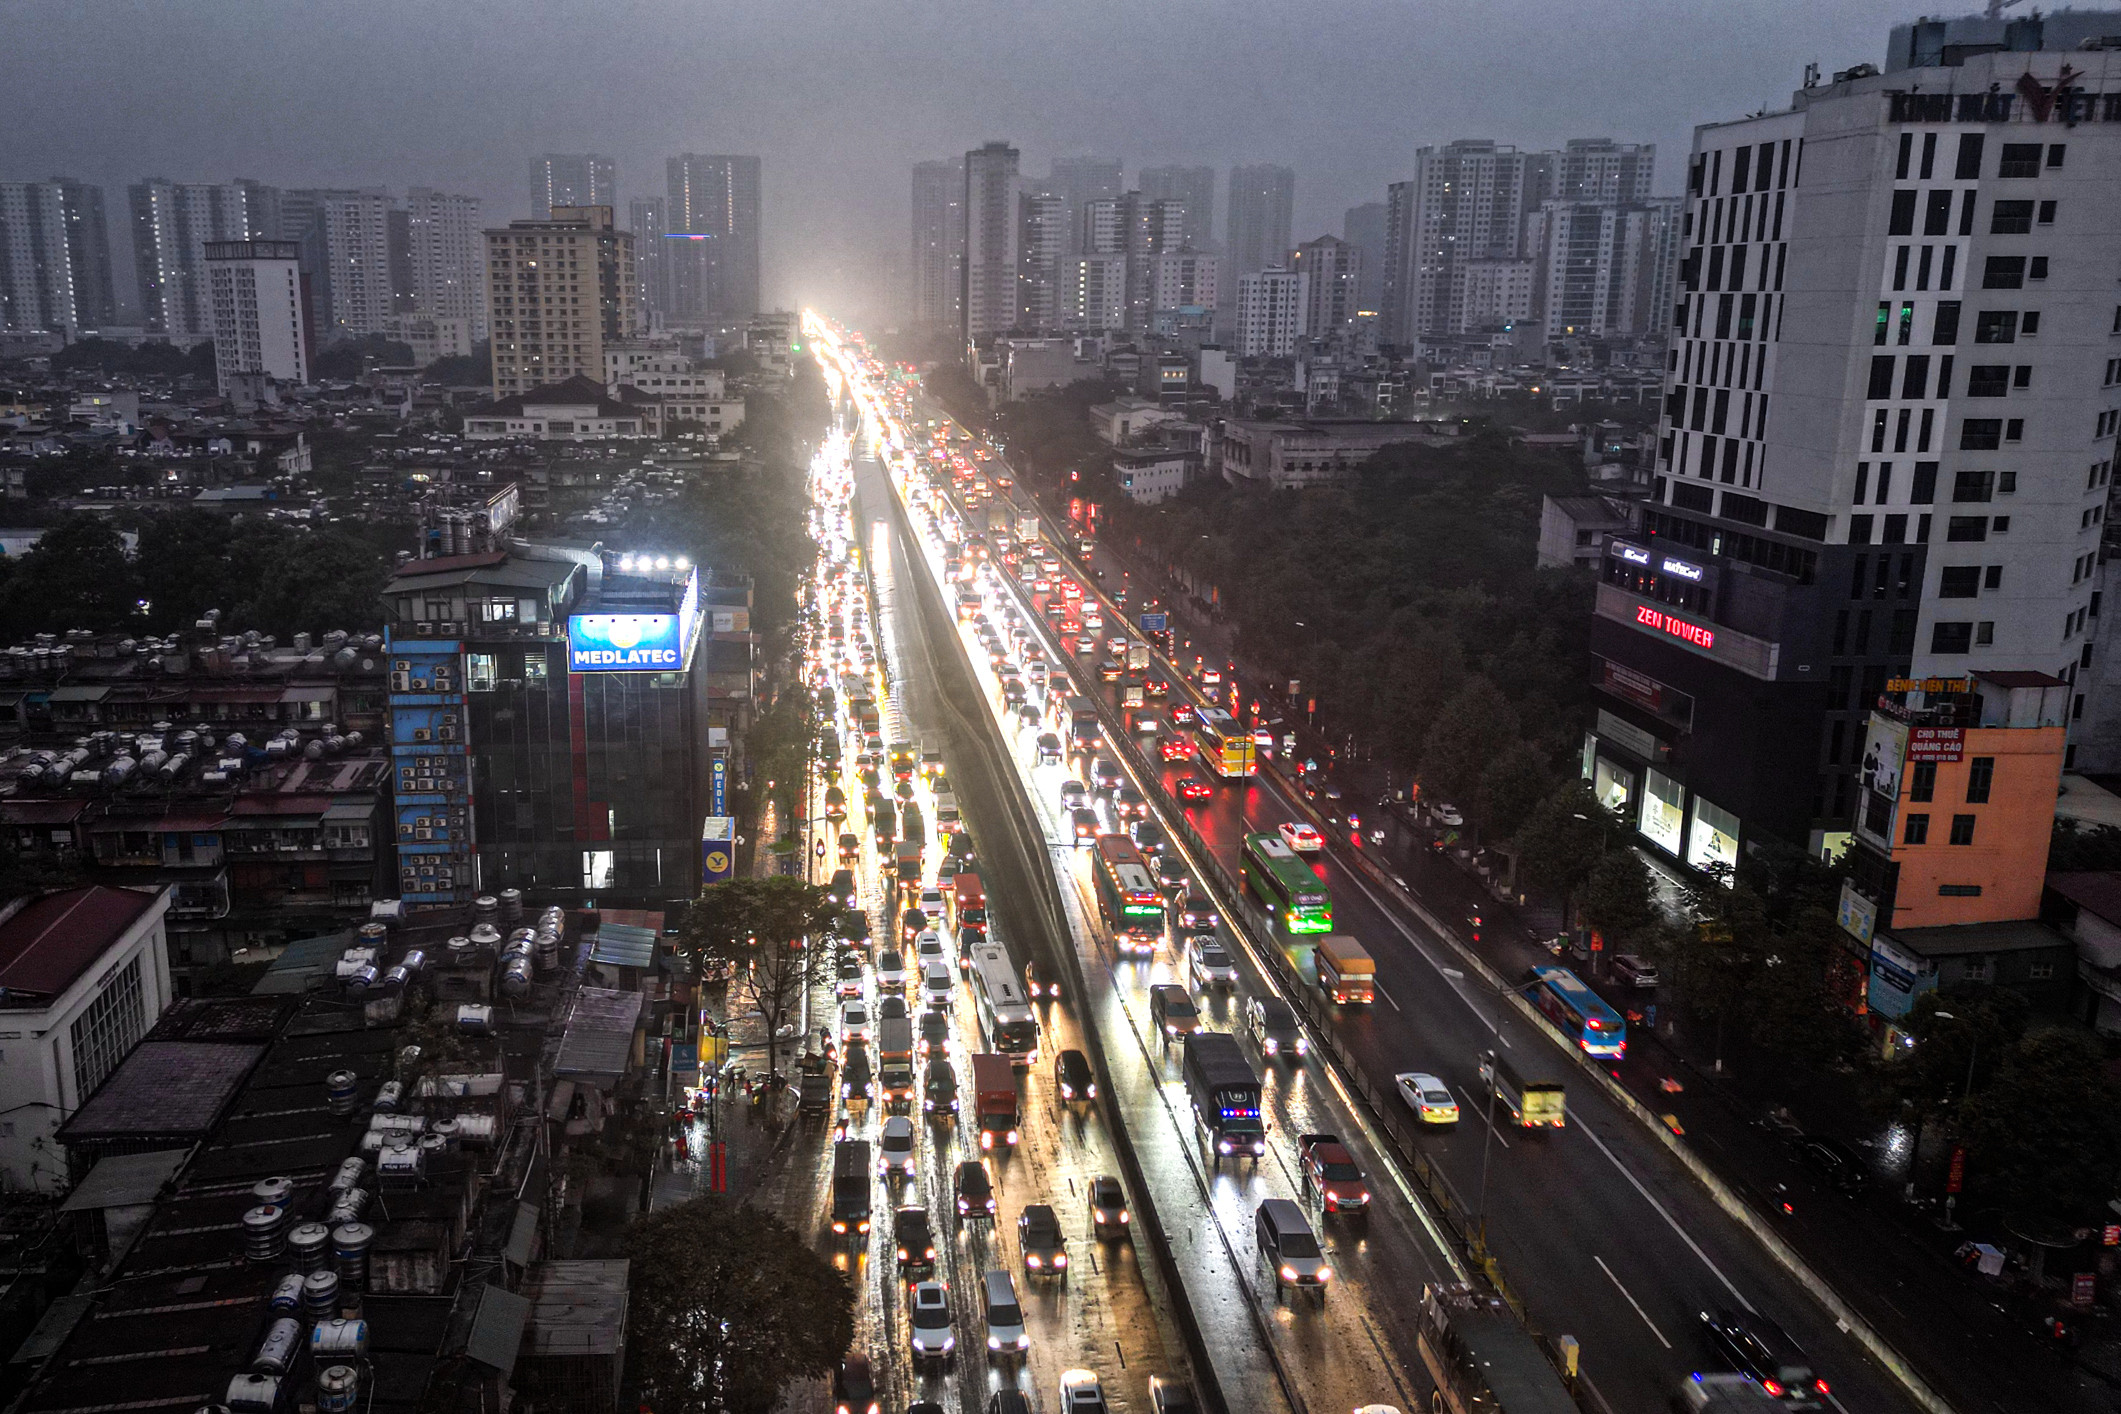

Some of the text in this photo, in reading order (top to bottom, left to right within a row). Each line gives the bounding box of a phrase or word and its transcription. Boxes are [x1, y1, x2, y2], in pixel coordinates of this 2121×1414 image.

[1636, 605, 1714, 649] ZEN TOWER
[574, 649, 677, 665] MEDLATEC
[1916, 728, 1960, 739] CHO THUÊ
[1911, 740, 1962, 752] QUẢNG CÁO
[715, 772, 723, 817] MEDLA
